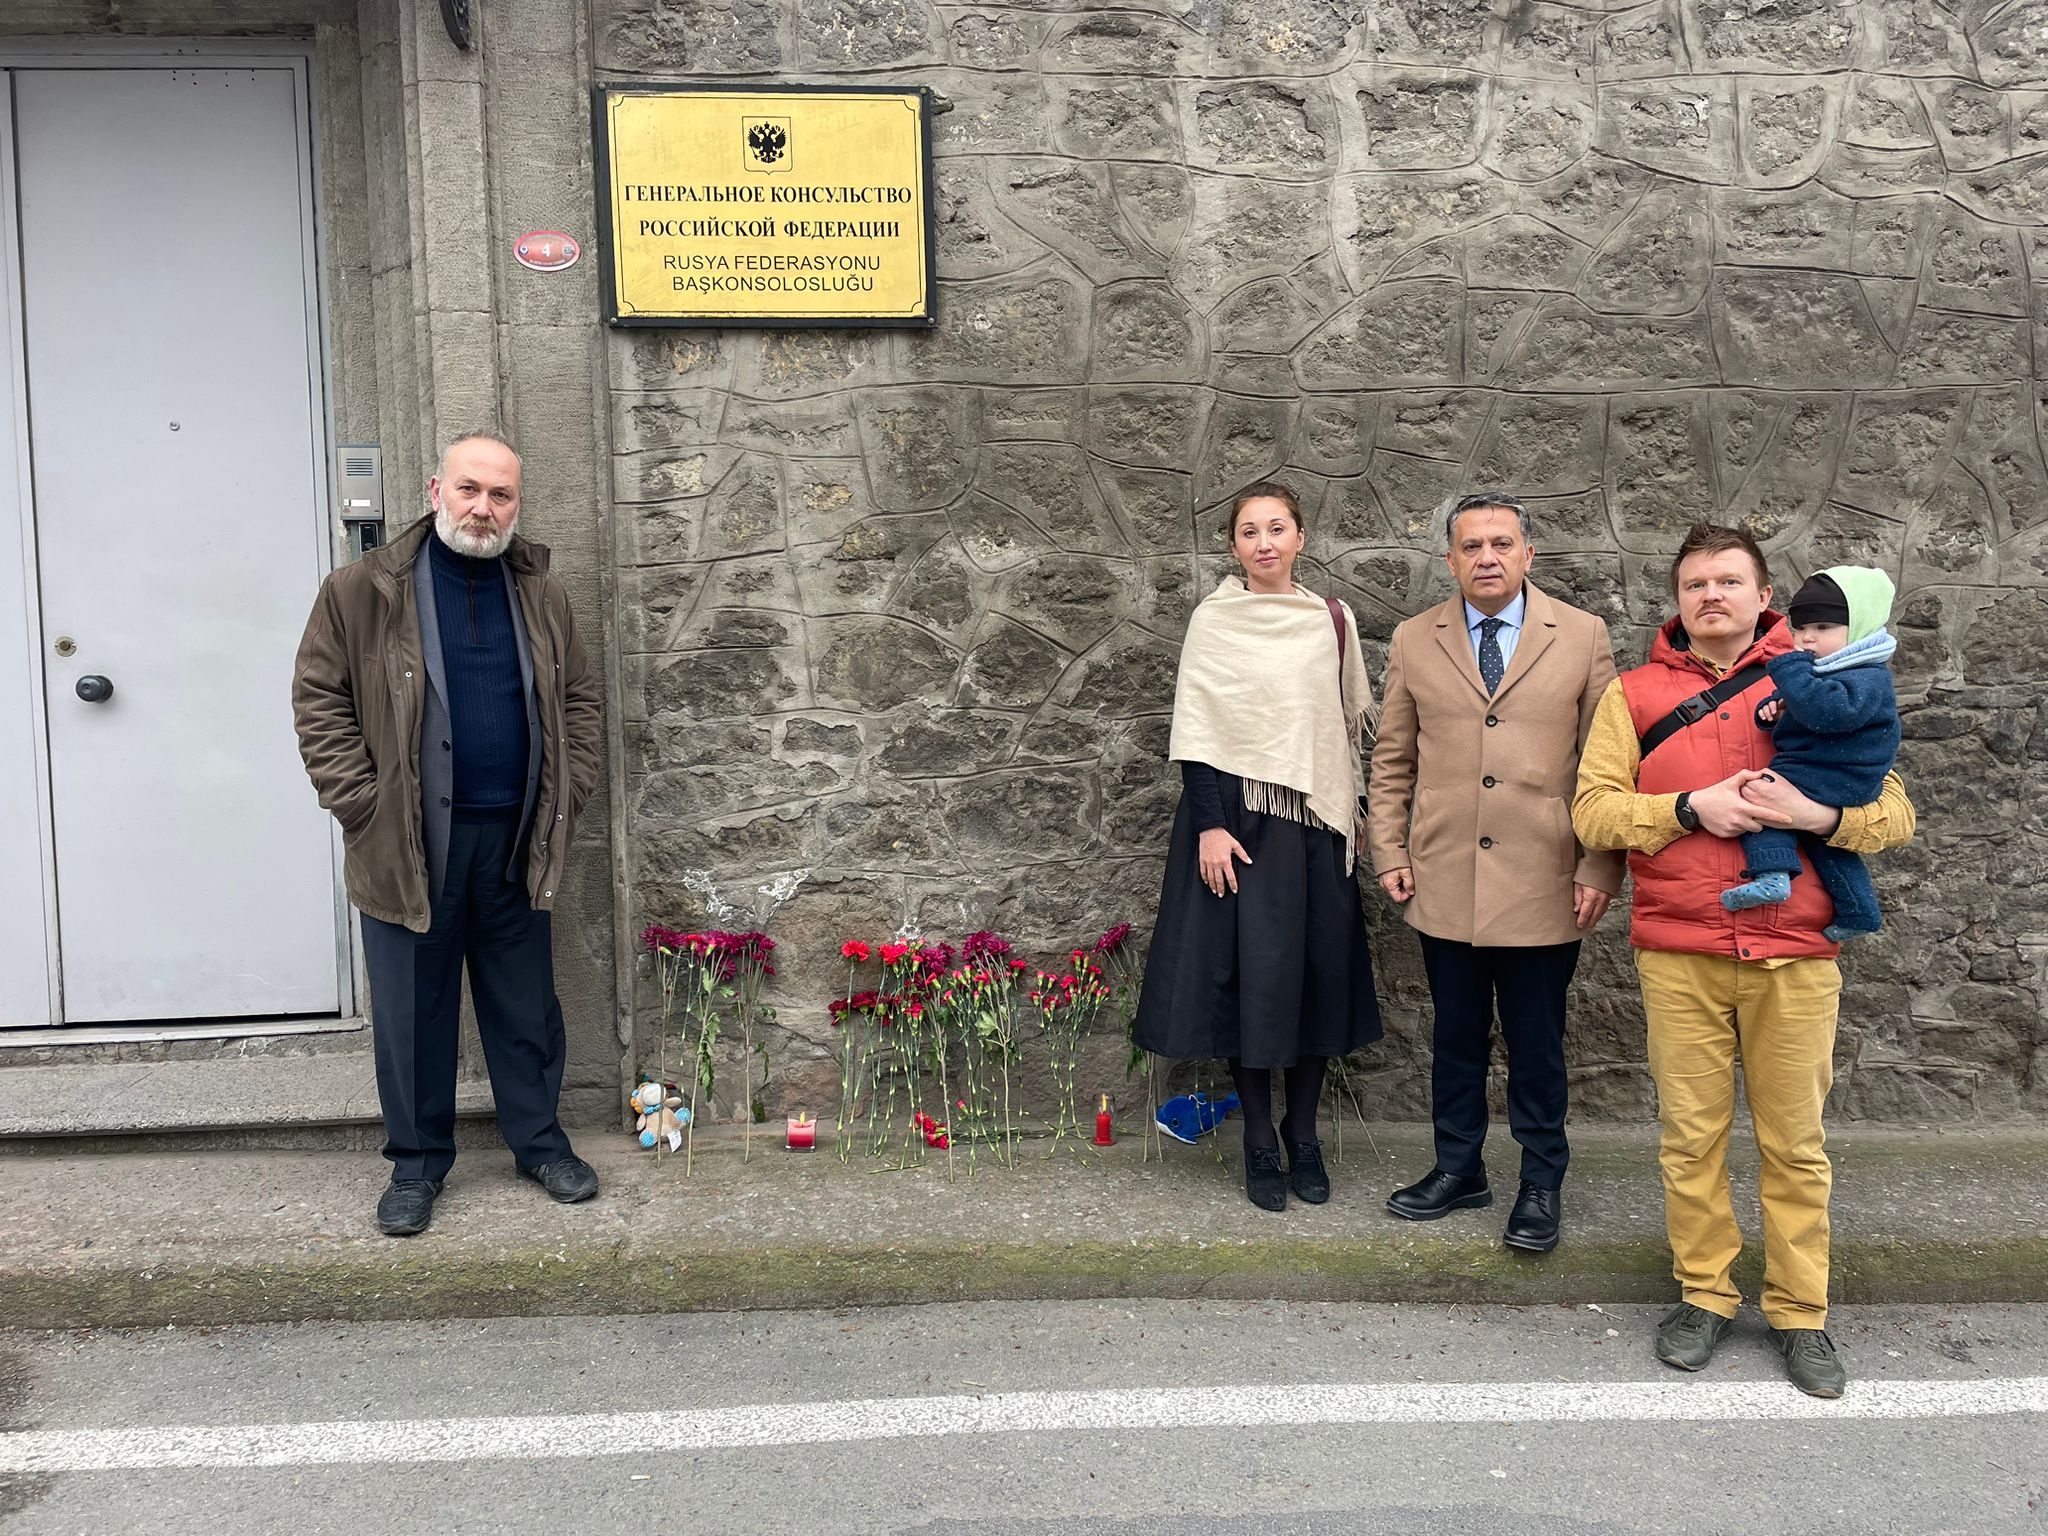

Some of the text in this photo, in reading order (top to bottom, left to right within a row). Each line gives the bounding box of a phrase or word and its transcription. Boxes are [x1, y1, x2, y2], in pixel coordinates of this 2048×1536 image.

[624, 184, 913, 204] ГЕНЕРАЛЬНОЕ КОНСУЛЬСТВО
[638, 216, 901, 241] РОССИЙСКОЙ ФЕДЕРАЦИИ
[541, 242, 552, 258] 4
[663, 255, 881, 271] RUSYA FEDERASYONU
[672, 273, 874, 295] BAŞKONSOLOSLUĞU
